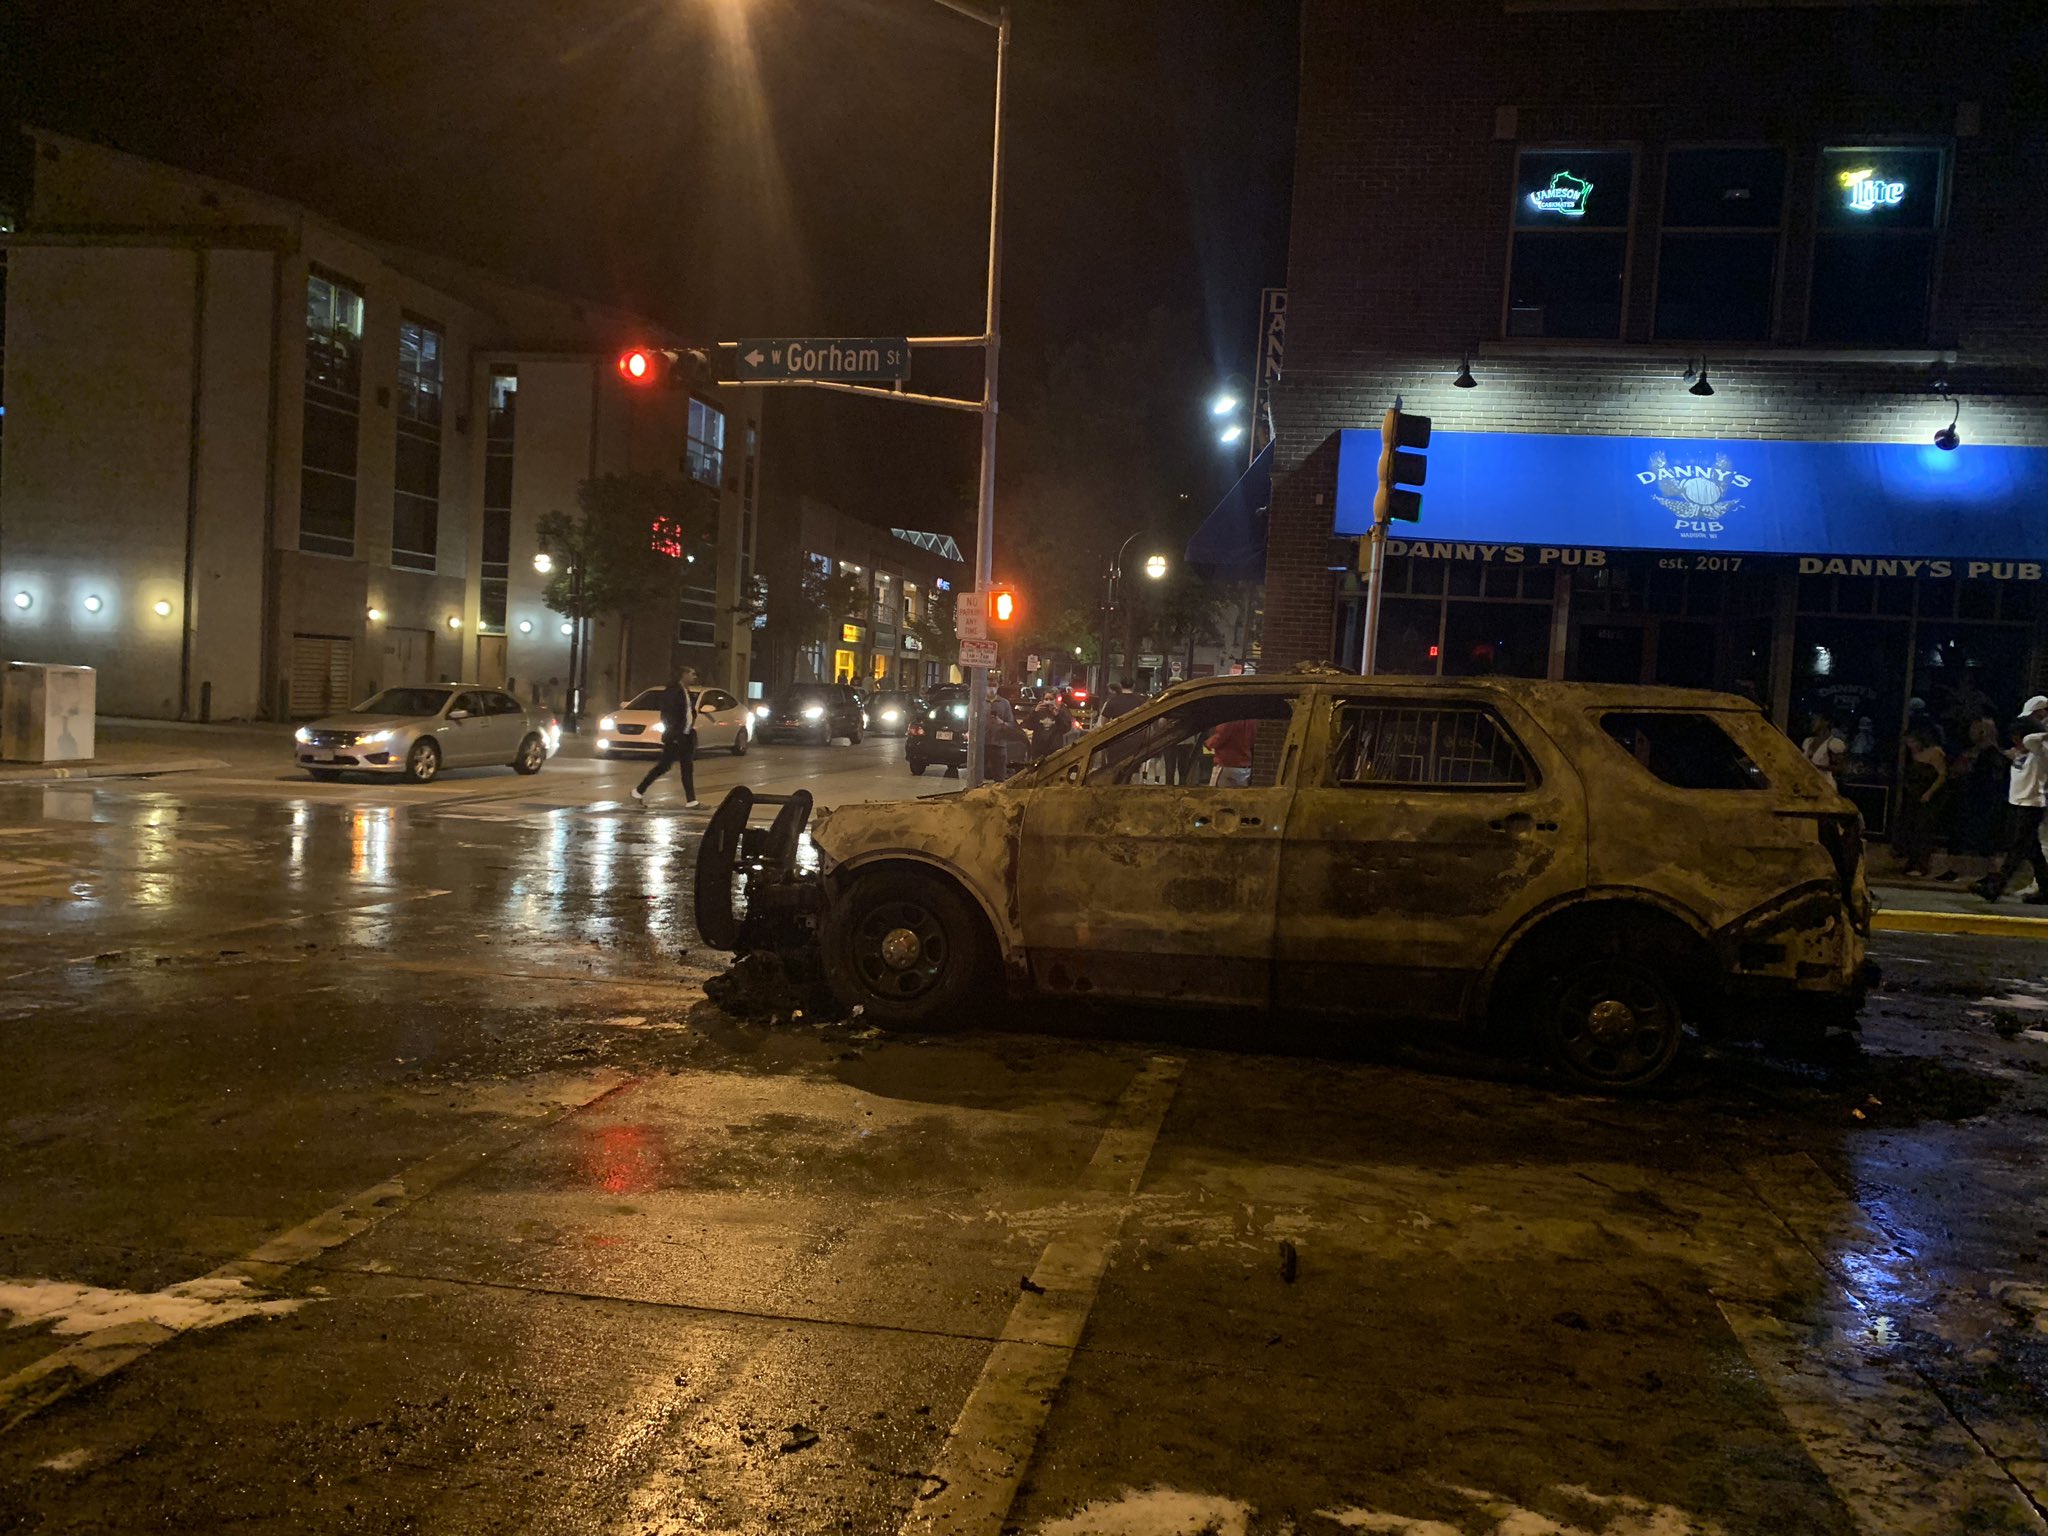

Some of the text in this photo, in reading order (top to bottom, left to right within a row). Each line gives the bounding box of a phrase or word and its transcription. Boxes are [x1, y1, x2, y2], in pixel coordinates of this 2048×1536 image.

[1535, 188, 1581, 201] JAMESON
[1850, 180, 1905, 211] Lite
[1265, 292, 1288, 384] DANN
[771, 343, 901, 372] W Gorham St
[1636, 465, 1753, 488] DANNY'S
[1674, 519, 1725, 532] PUB
[1385, 539, 1607, 567] DANNY'S PUB
[1658, 556, 1743, 572] est. 2017
[1799, 557, 2042, 580] DANNY'S PUB
[966, 597, 977, 607] NO
